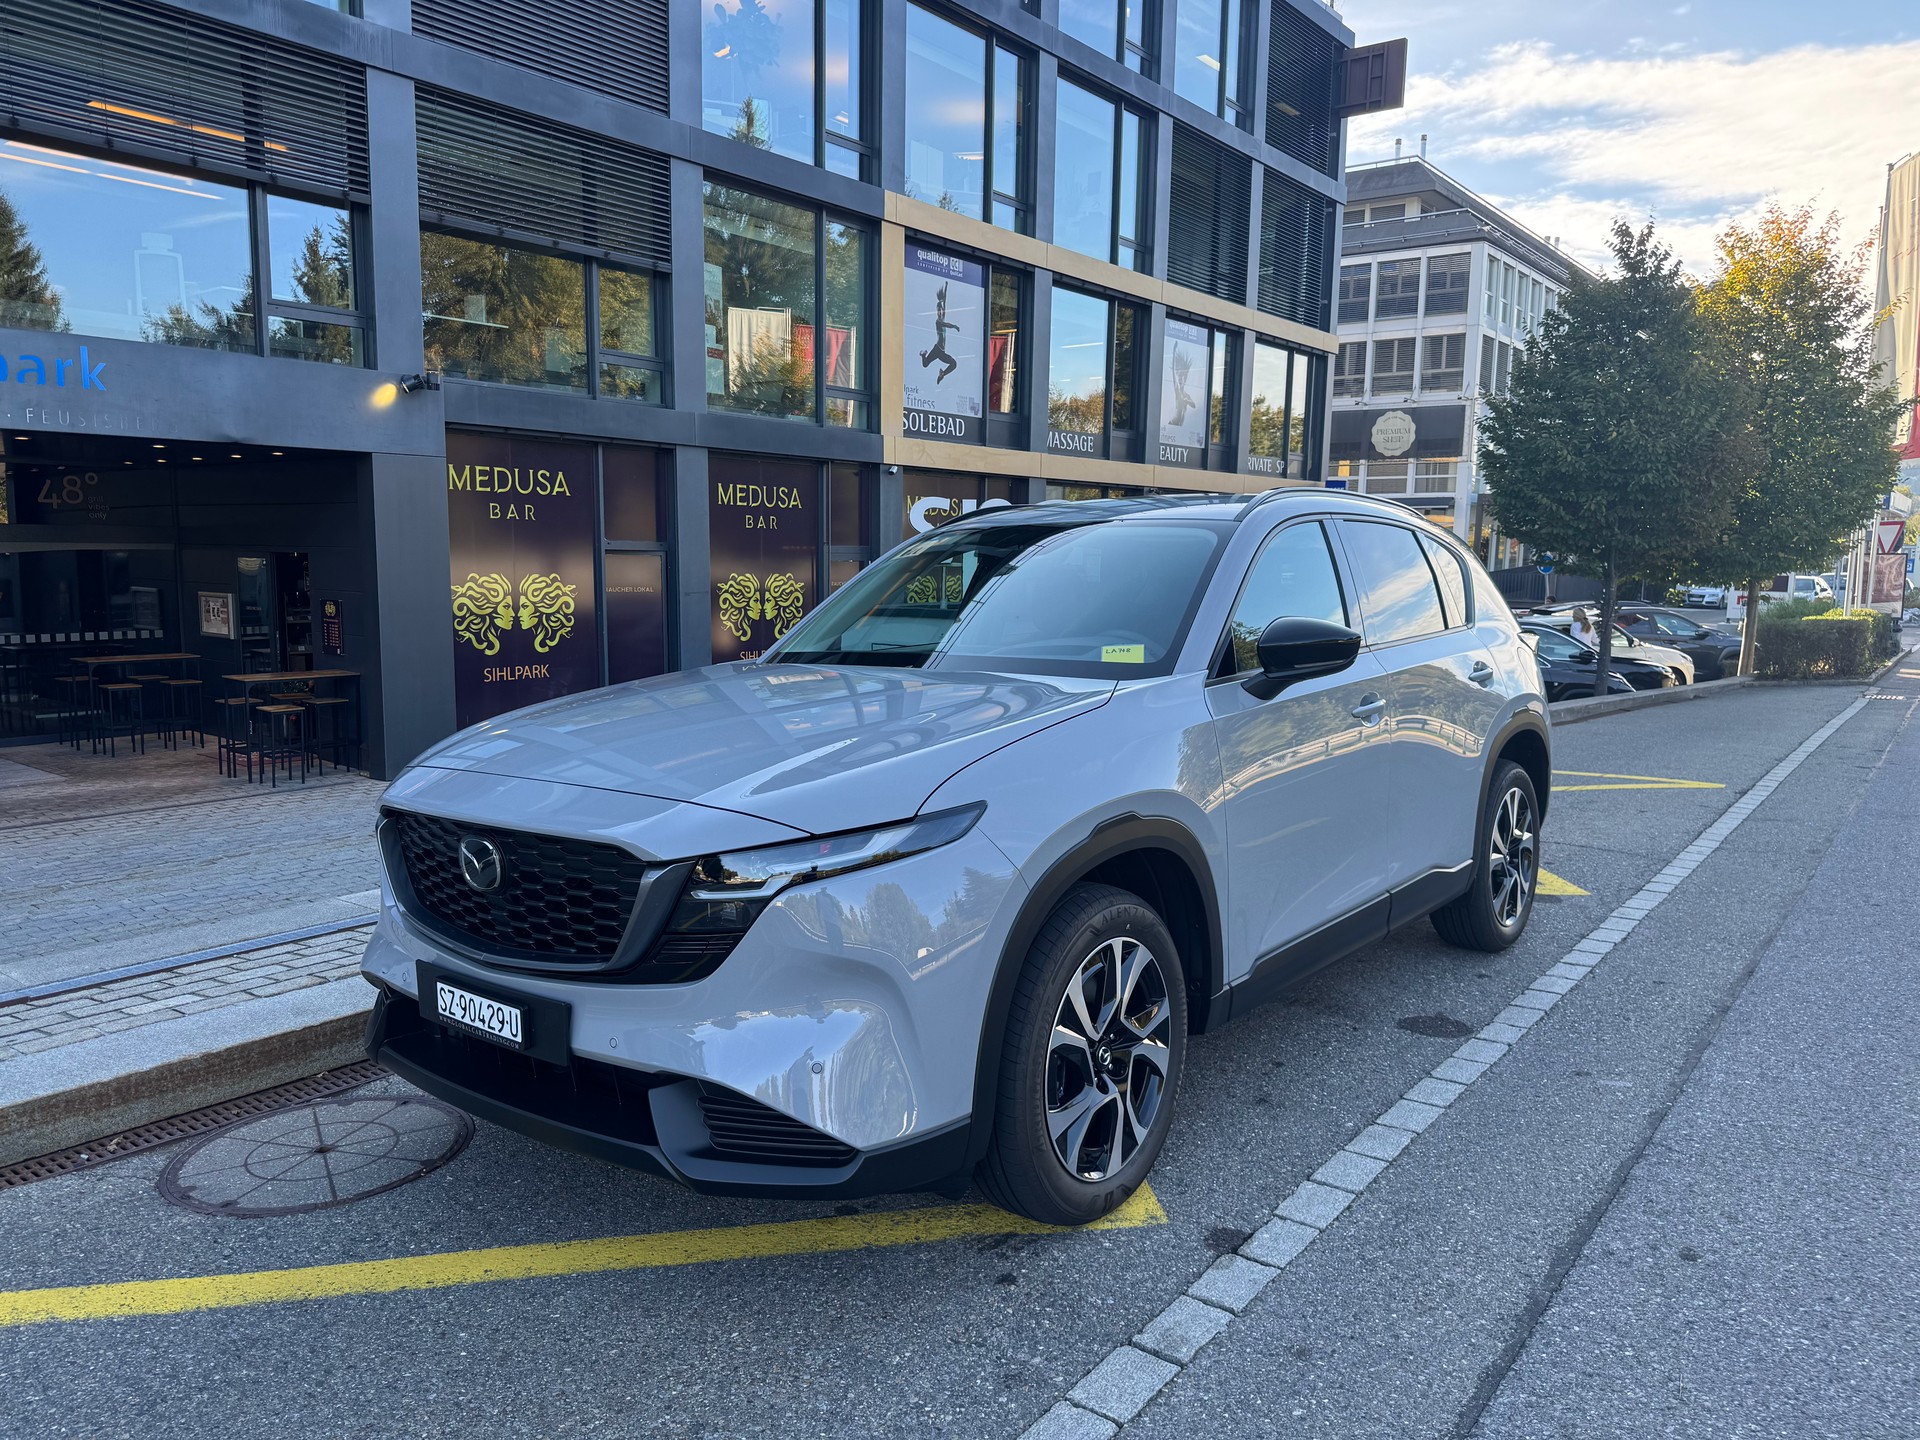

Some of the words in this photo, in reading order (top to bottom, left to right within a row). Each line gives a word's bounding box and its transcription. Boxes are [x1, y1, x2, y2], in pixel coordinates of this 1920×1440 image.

[917, 250, 949, 266] qualitop
[906, 393, 936, 409] fitness
[1376, 428, 1411, 436] PREMIUM
[448, 463, 571, 497] MEDUSA
[717, 482, 803, 509] MEDUSA
[489, 502, 536, 521] BAR
[745, 514, 778, 530] BAR
[483, 663, 550, 683] SIHLPARK
